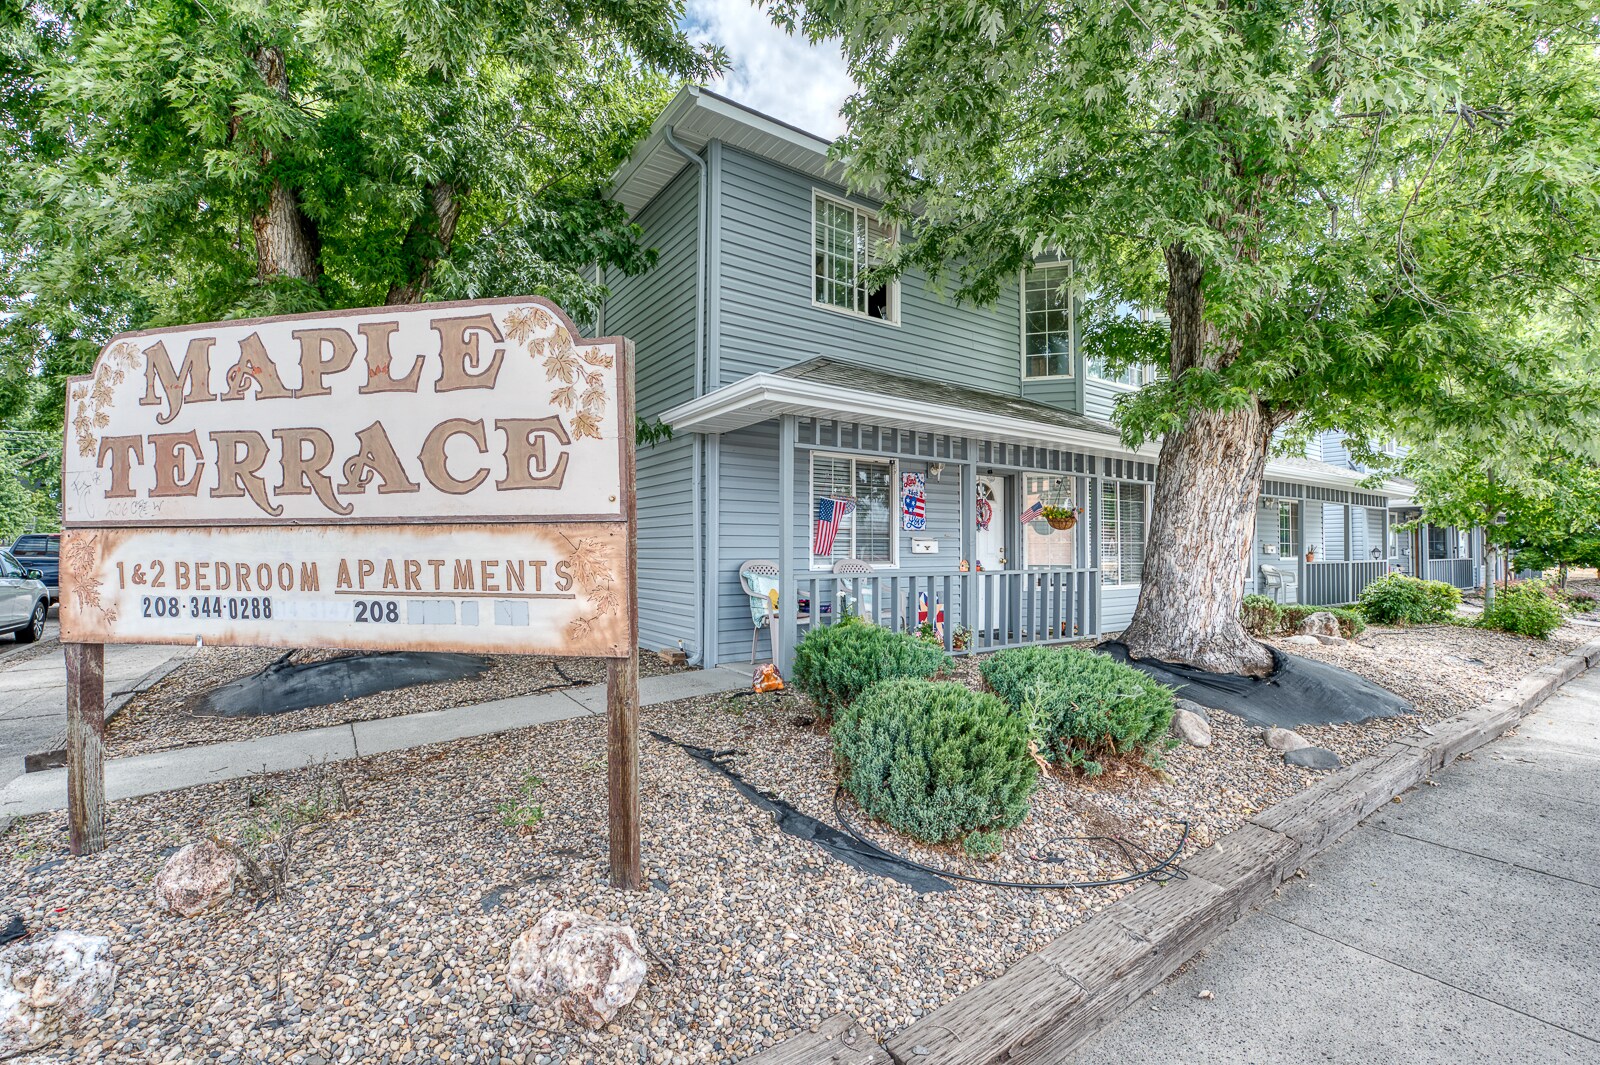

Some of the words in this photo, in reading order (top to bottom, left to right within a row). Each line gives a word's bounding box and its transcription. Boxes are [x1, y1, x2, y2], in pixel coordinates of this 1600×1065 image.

[138, 314, 506, 425] MAPLE
[96, 415, 572, 517] TERRACE
[117, 559, 166, 590] 1&2
[175, 560, 320, 592] BEDROOM
[336, 558, 575, 593] APARTMENTS
[354, 600, 400, 623] 208
